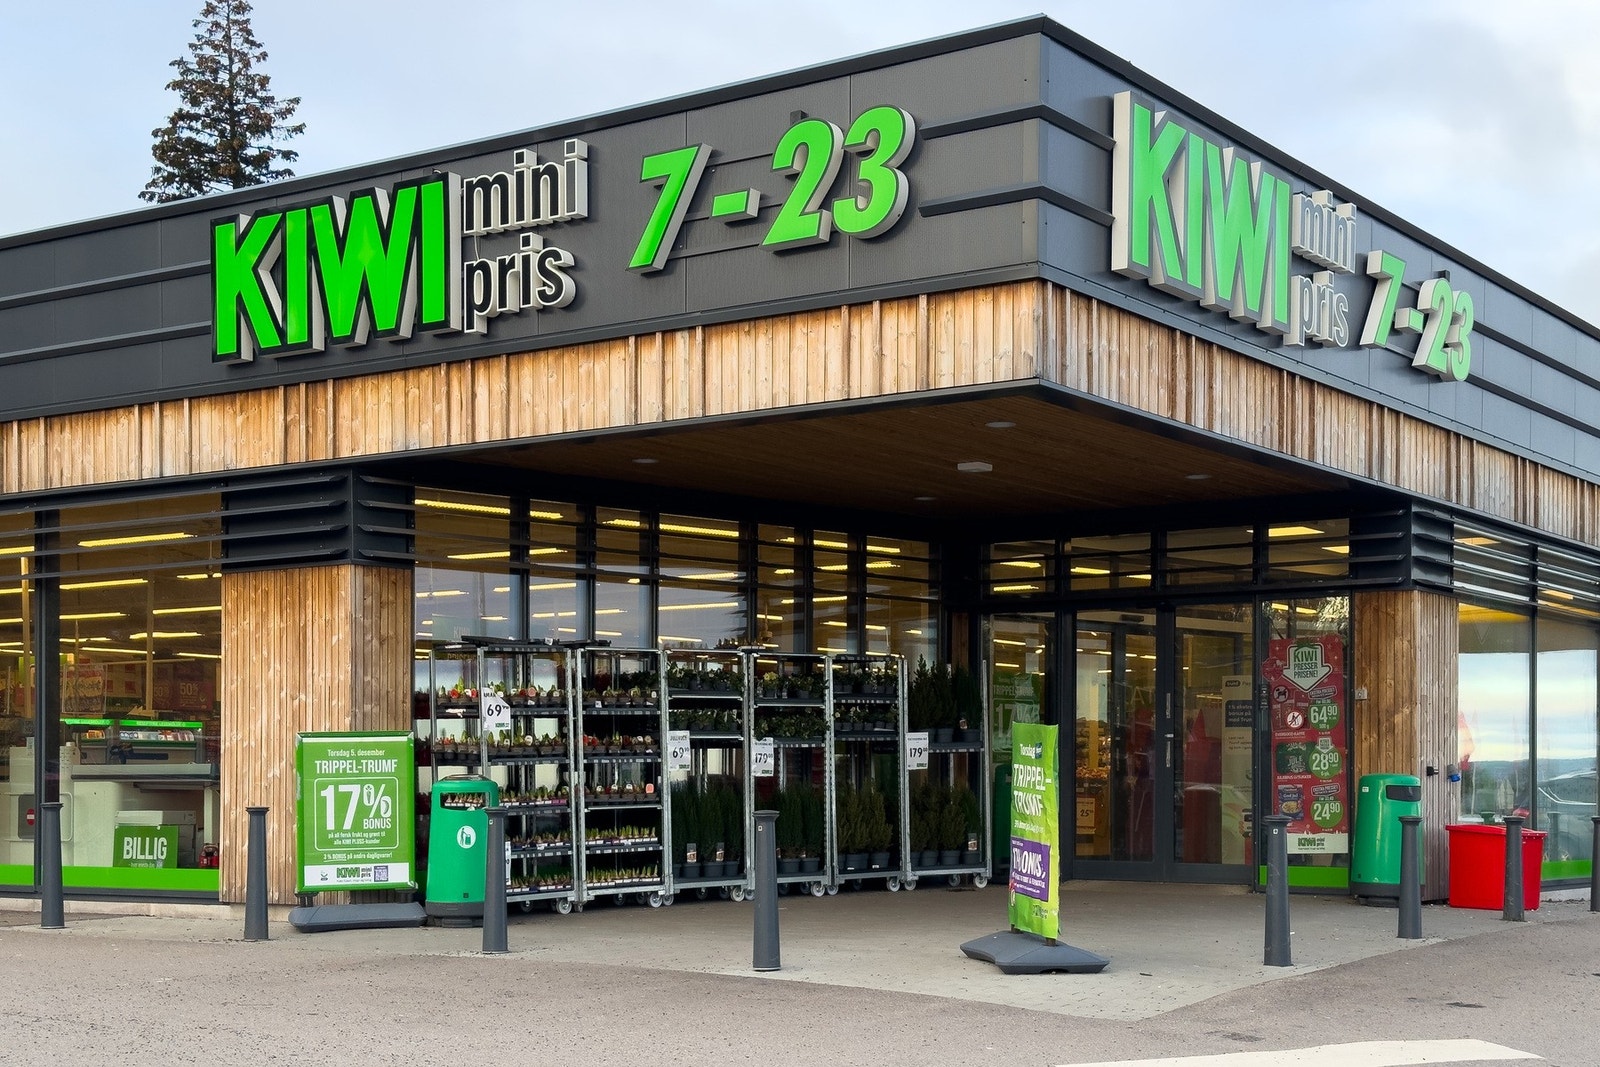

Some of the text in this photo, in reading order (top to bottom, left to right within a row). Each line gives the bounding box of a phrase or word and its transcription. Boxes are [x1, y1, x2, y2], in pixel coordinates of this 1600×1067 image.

[463, 138, 588, 235] mini
[1112, 91, 1291, 334] KIWI
[1291, 189, 1357, 274] mini
[211, 171, 461, 364] KIWI
[464, 231, 576, 334] pris
[1283, 270, 1350, 348] pris
[1294, 650, 1317, 662] KIWI
[1294, 662, 1318, 670] PRESSER
[315, 759, 398, 774] TRIPPEL-TRUMF
[328, 749, 386, 758] Torsdag 5. desember
[320, 784, 392, 830] 17%
[1013, 790, 1043, 817] TRUMF
[363, 818, 392, 829] BONUS
[123, 837, 167, 860] BILLIG
[336, 867, 360, 878] KIWI
